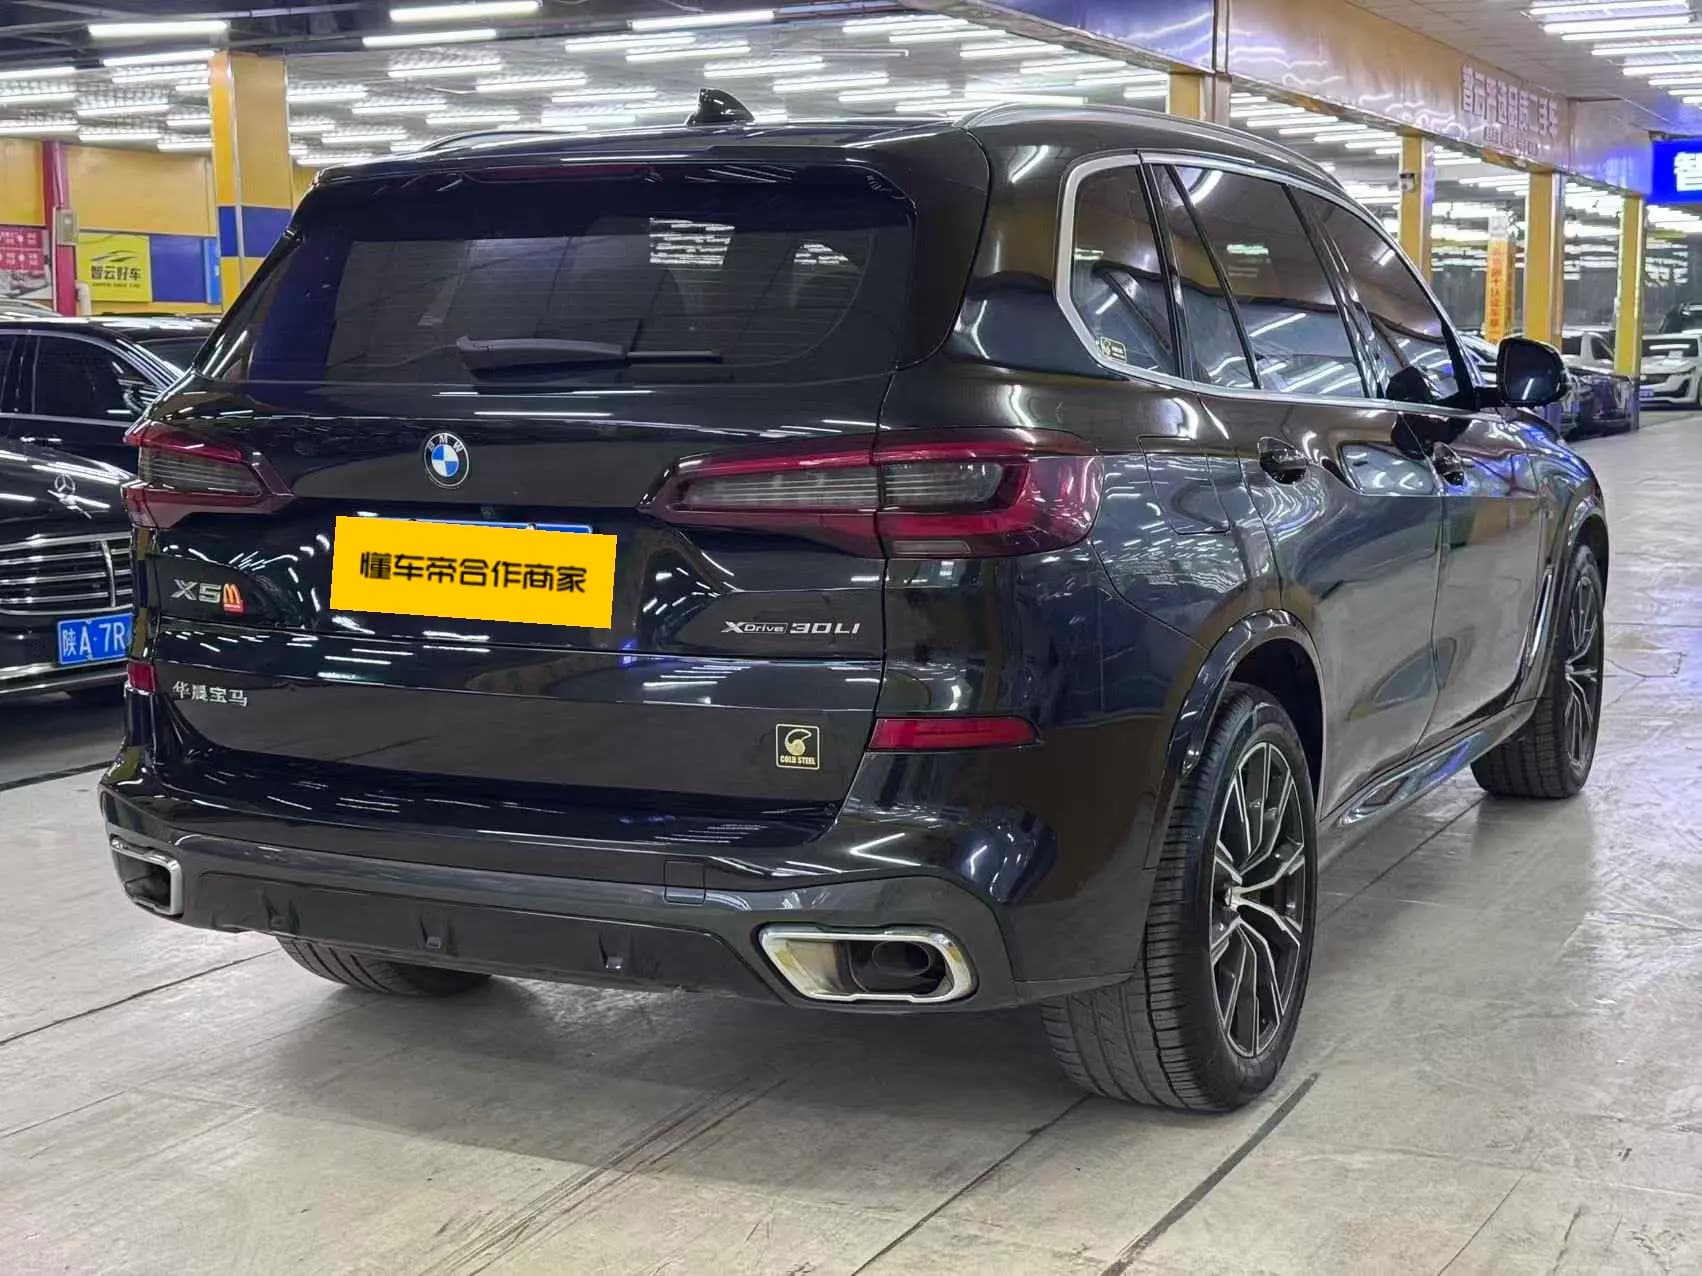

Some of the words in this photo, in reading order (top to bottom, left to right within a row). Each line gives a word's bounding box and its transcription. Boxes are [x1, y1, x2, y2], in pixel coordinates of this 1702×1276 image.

[91, 265, 141, 280] 智云好车
[172, 681, 247, 707] 华晨宝马
